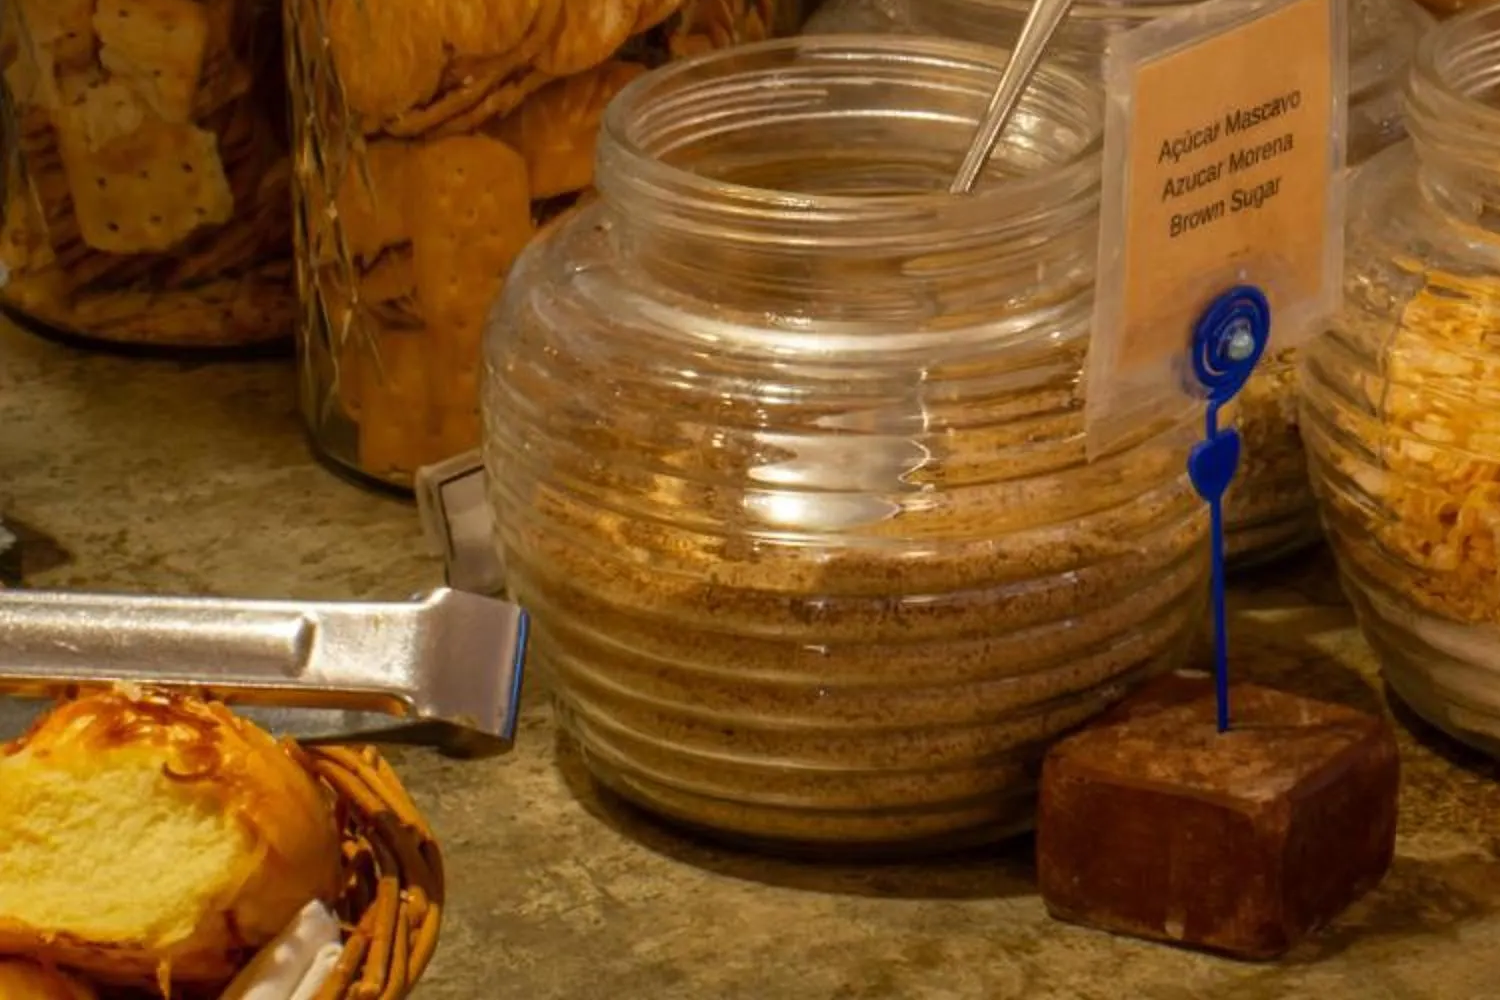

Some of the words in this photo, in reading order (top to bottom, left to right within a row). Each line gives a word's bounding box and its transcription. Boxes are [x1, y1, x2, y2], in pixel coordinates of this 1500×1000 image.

[1224, 90, 1301, 136] Mascavo
[1228, 133, 1294, 175] Morena
[1170, 199, 1225, 238] Brown
[1230, 176, 1282, 212] Sugar
